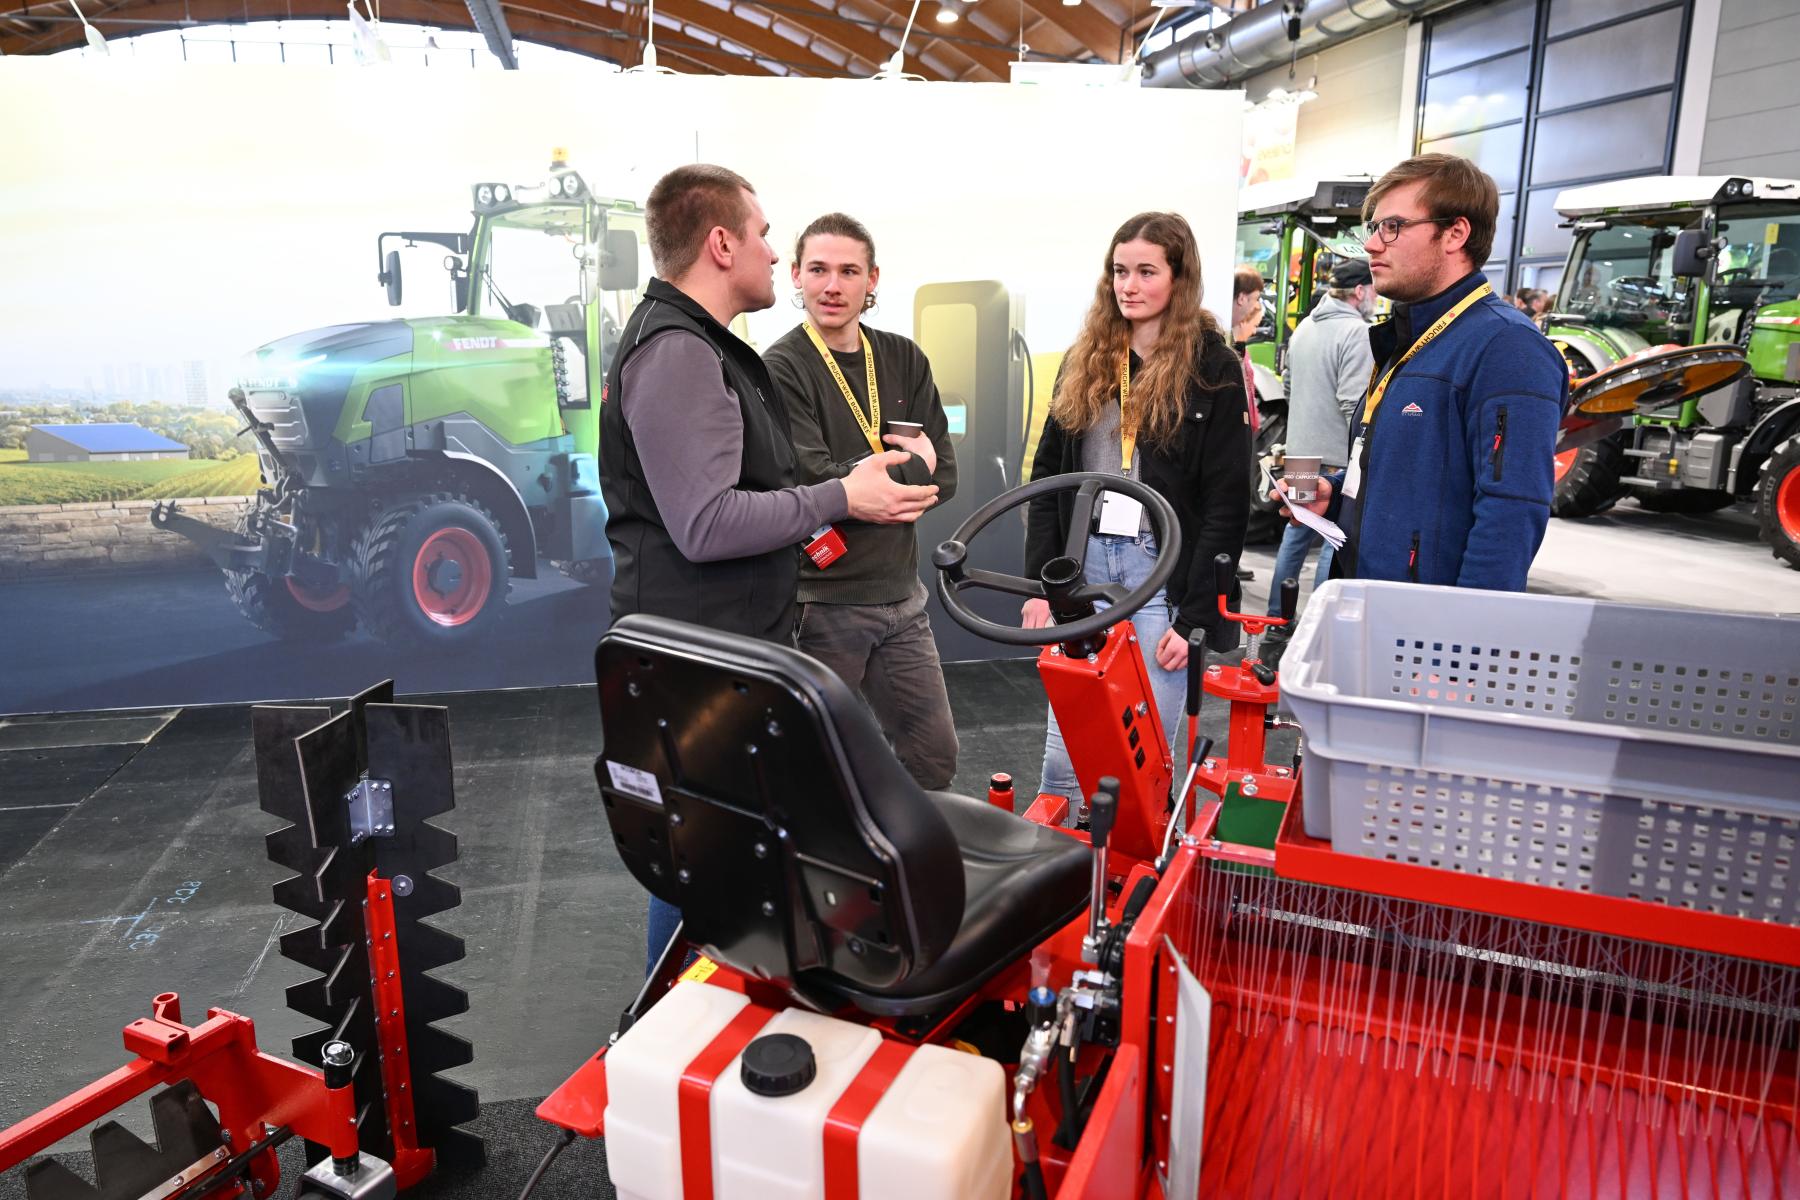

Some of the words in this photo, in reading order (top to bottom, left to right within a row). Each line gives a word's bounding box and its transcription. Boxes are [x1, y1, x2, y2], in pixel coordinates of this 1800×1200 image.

[452, 336, 497, 350] FENDT
[867, 352, 876, 388] BODENSEE
[850, 401, 870, 433] BODENSEE
